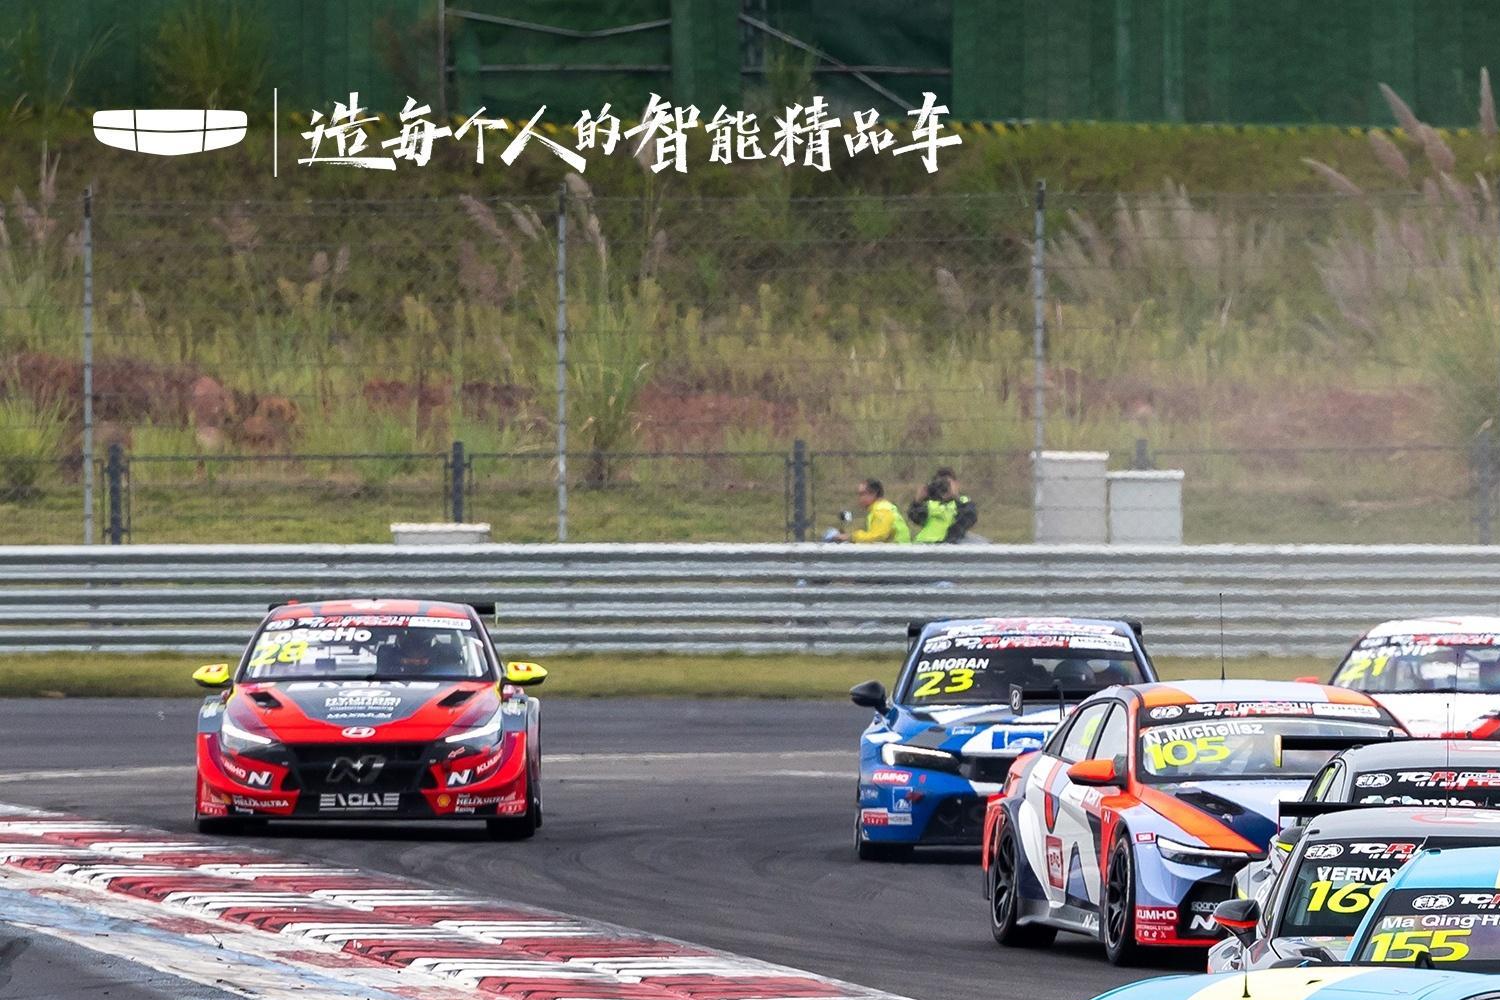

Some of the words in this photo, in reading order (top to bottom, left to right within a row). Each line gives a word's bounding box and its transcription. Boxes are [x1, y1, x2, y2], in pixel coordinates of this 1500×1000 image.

[249, 640, 308, 667] 28
[917, 658, 990, 672] D.MORAN
[1338, 655, 1390, 682] 21
[913, 668, 976, 697] 23
[1144, 736, 1231, 770] 105
[1304, 844, 1343, 859] FIA
[1350, 843, 1416, 854] TCR
[1413, 895, 1453, 909] FIA
[1382, 916, 1415, 929] Ma
[1421, 914, 1477, 929] Qing
[1370, 929, 1473, 963] 155
